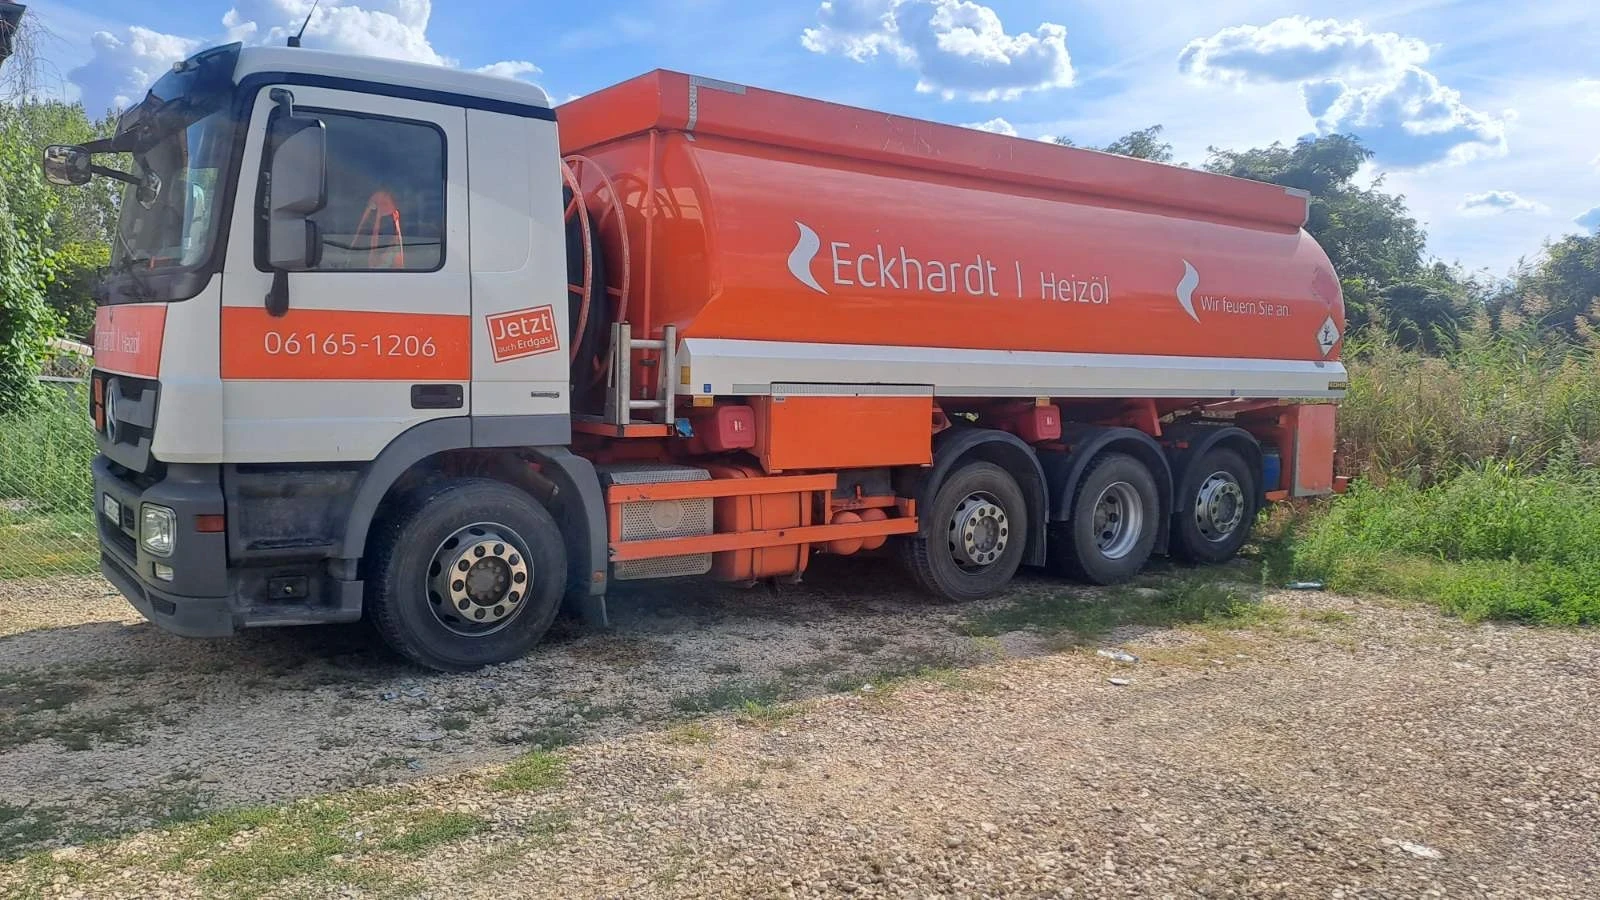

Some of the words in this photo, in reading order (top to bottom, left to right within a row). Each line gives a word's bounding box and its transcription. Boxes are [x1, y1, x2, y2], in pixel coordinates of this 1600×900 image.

[830, 241, 999, 297] Eckhardt
[1040, 271, 1109, 305] Heizöl
[1200, 295, 1219, 312] Wir
[1222, 296, 1256, 314] feuern
[1258, 301, 1274, 316] Sie
[495, 313, 551, 340] Jetzt
[264, 331, 437, 357] 06165-1206
[498, 343, 517, 353] auch
[517, 334, 554, 349] Erdgas!
